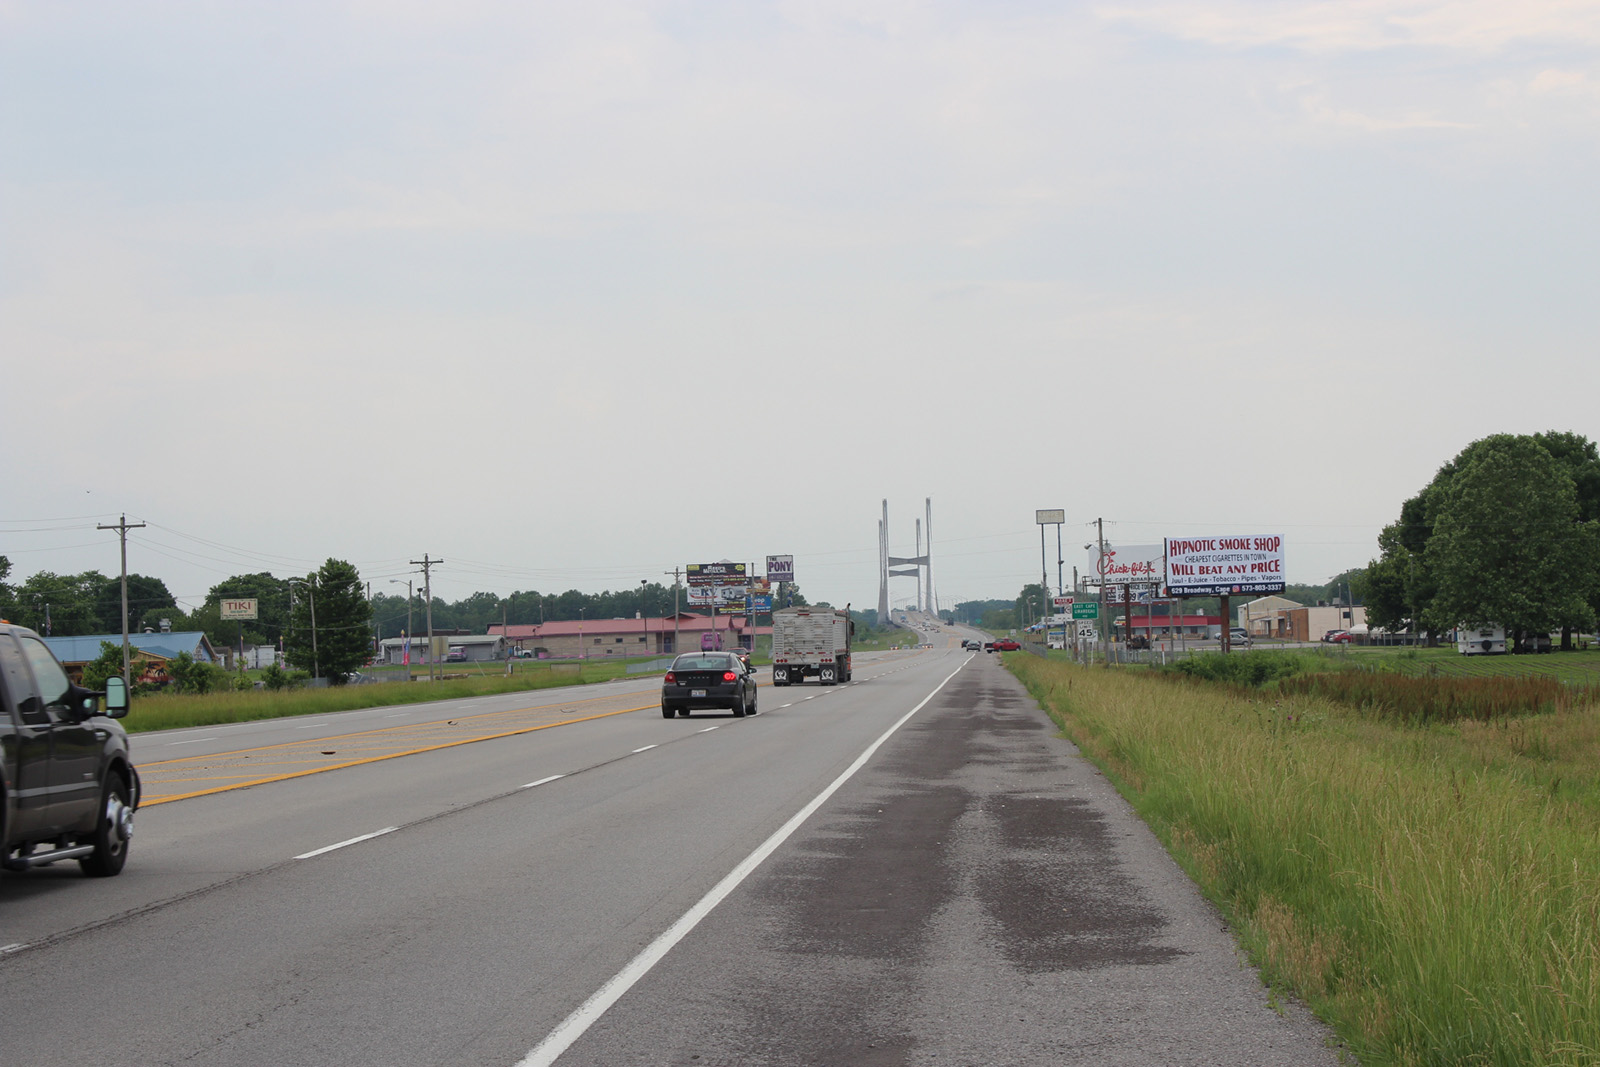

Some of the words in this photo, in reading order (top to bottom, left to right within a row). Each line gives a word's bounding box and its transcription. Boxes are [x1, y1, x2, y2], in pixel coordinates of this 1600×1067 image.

[1170, 540, 1216, 557] HYPNOTIC
[1219, 538, 1251, 550] SMOKE
[1254, 536, 1280, 552] SHOP
[1184, 555, 1211, 563] CHEAPEST
[1212, 554, 1243, 562] CIGARETTES
[768, 562, 792, 572] PONY
[1171, 563, 1195, 576] WILL
[1199, 566, 1223, 574] BEAT
[1226, 564, 1248, 574] ANY
[1251, 559, 1280, 573] PRICE
